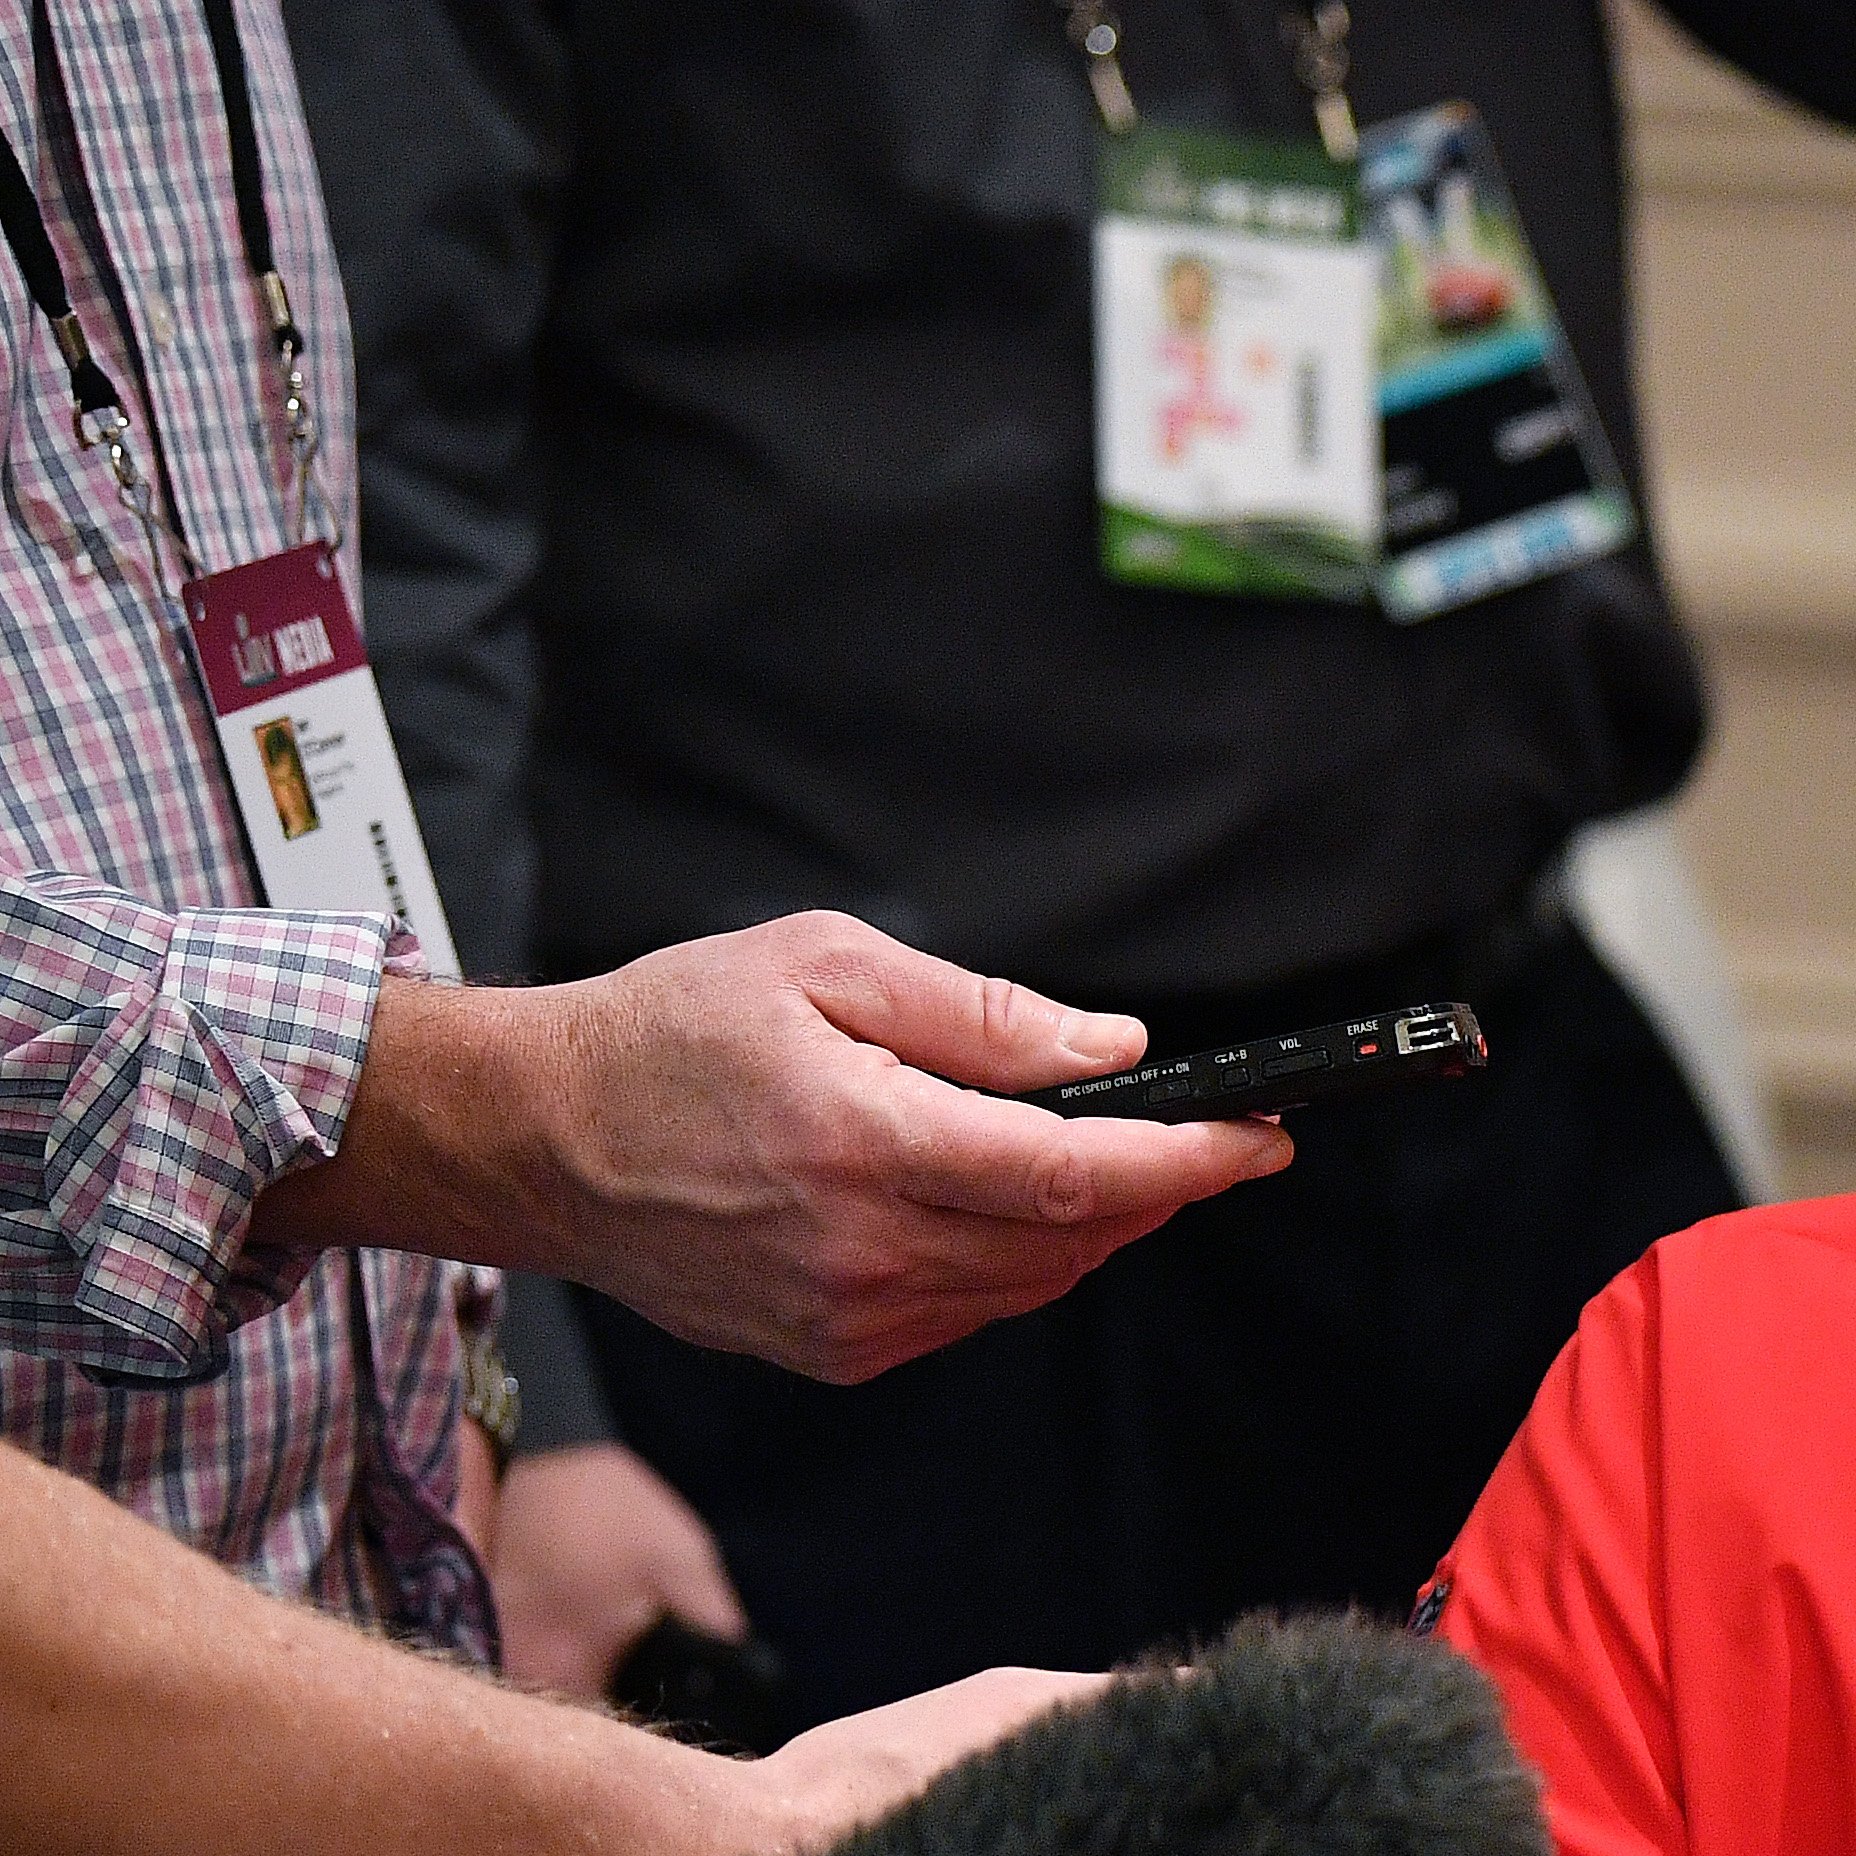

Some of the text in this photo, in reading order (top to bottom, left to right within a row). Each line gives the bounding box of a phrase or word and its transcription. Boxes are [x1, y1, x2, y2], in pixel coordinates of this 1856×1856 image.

[1347, 1019, 1379, 1036] ERASE
[1279, 1037, 1302, 1051] VOL
[1141, 1068, 1159, 1081] OFF
[1176, 1062, 1190, 1074] ON
